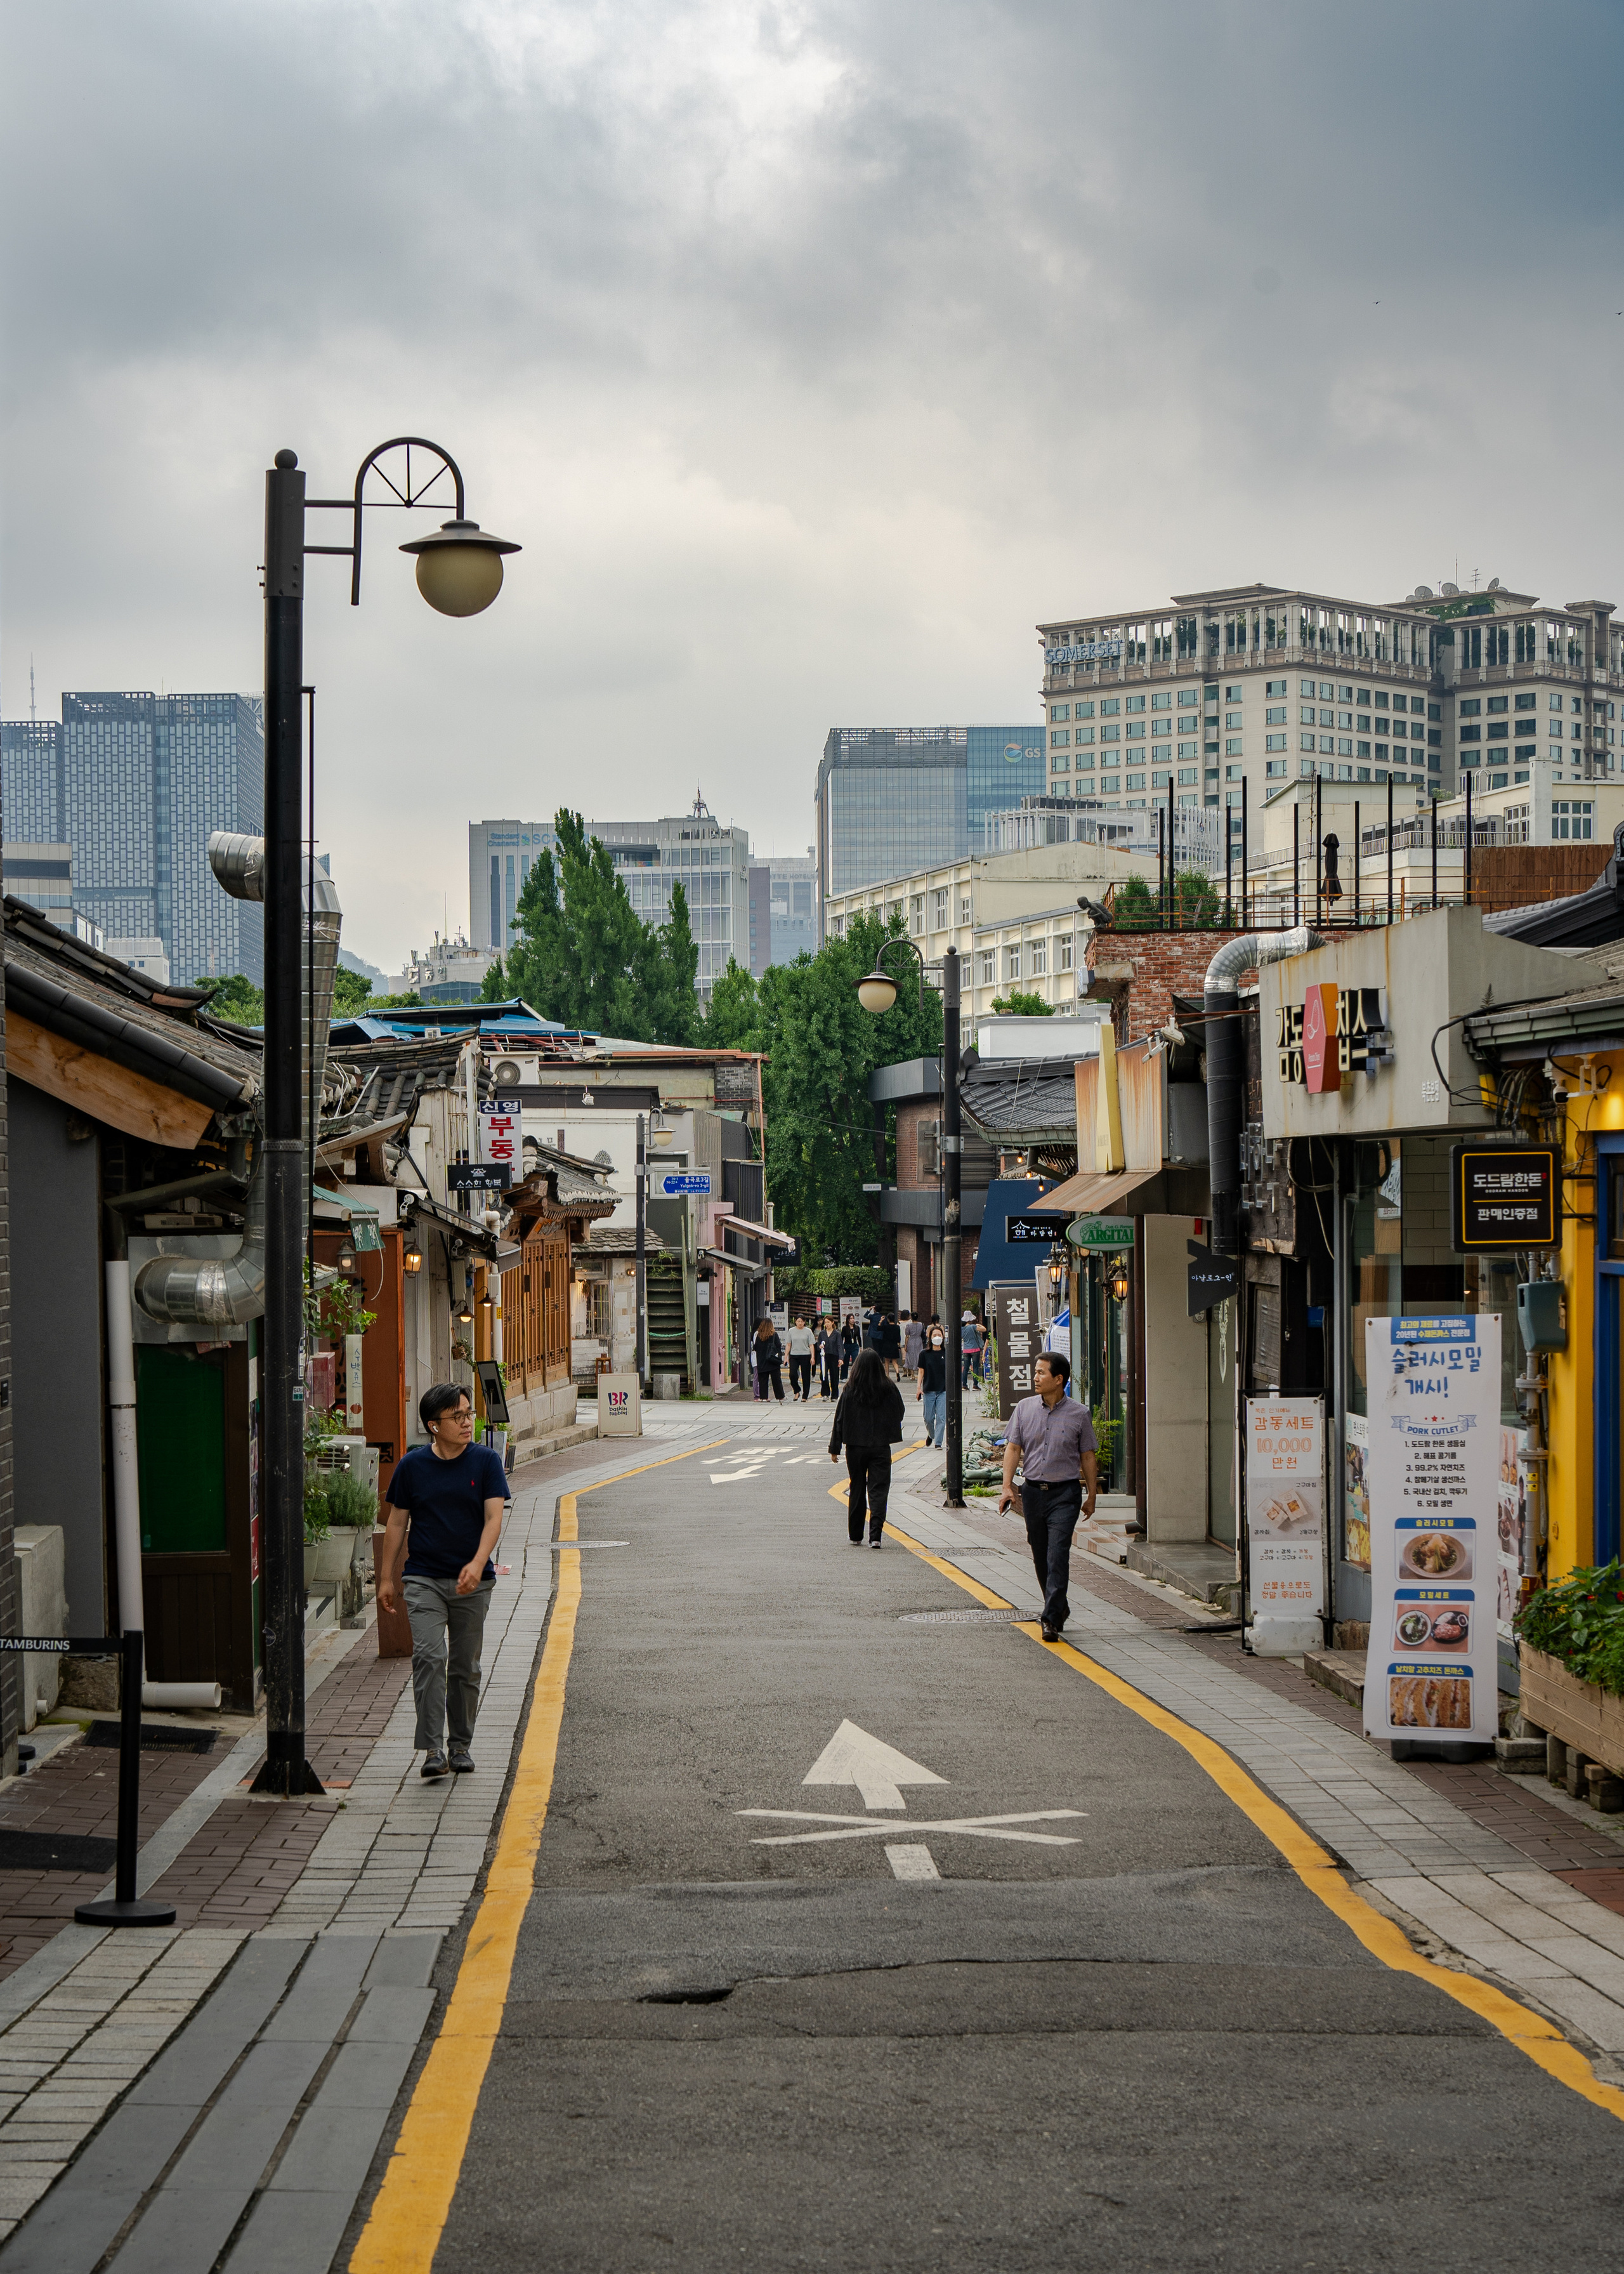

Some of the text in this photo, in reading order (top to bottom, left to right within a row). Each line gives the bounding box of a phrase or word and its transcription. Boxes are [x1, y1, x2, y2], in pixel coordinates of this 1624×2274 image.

[1045, 640, 1123, 664] SOMERSET
[482, 1101, 518, 1113] 신영
[488, 1117, 515, 1183] 부동
[457, 1178, 502, 1188] 소소한 행복
[1473, 1173, 1542, 1187] 도드람한돈
[1477, 1208, 1538, 1221] 판매인증점
[1400, 1320, 1419, 1329] 최고의
[1440, 1319, 1467, 1327] 고집하는
[1396, 1330, 1417, 1338] 20년된
[1451, 1329, 1470, 1337] 전문점
[1006, 1298, 1032, 1391] 철물점
[1391, 1346, 1482, 1374] 슬러시모밀
[1405, 1376, 1448, 1398] 개시!
[608, 1391, 629, 1405] BR
[1255, 1416, 1314, 1431] 감동세트
[1407, 1425, 1459, 1435] PORK CUTLET
[1257, 1436, 1312, 1456] 10,000
[1273, 1457, 1297, 1469] 만원
[0, 1638, 70, 1650] TAMBURINS
